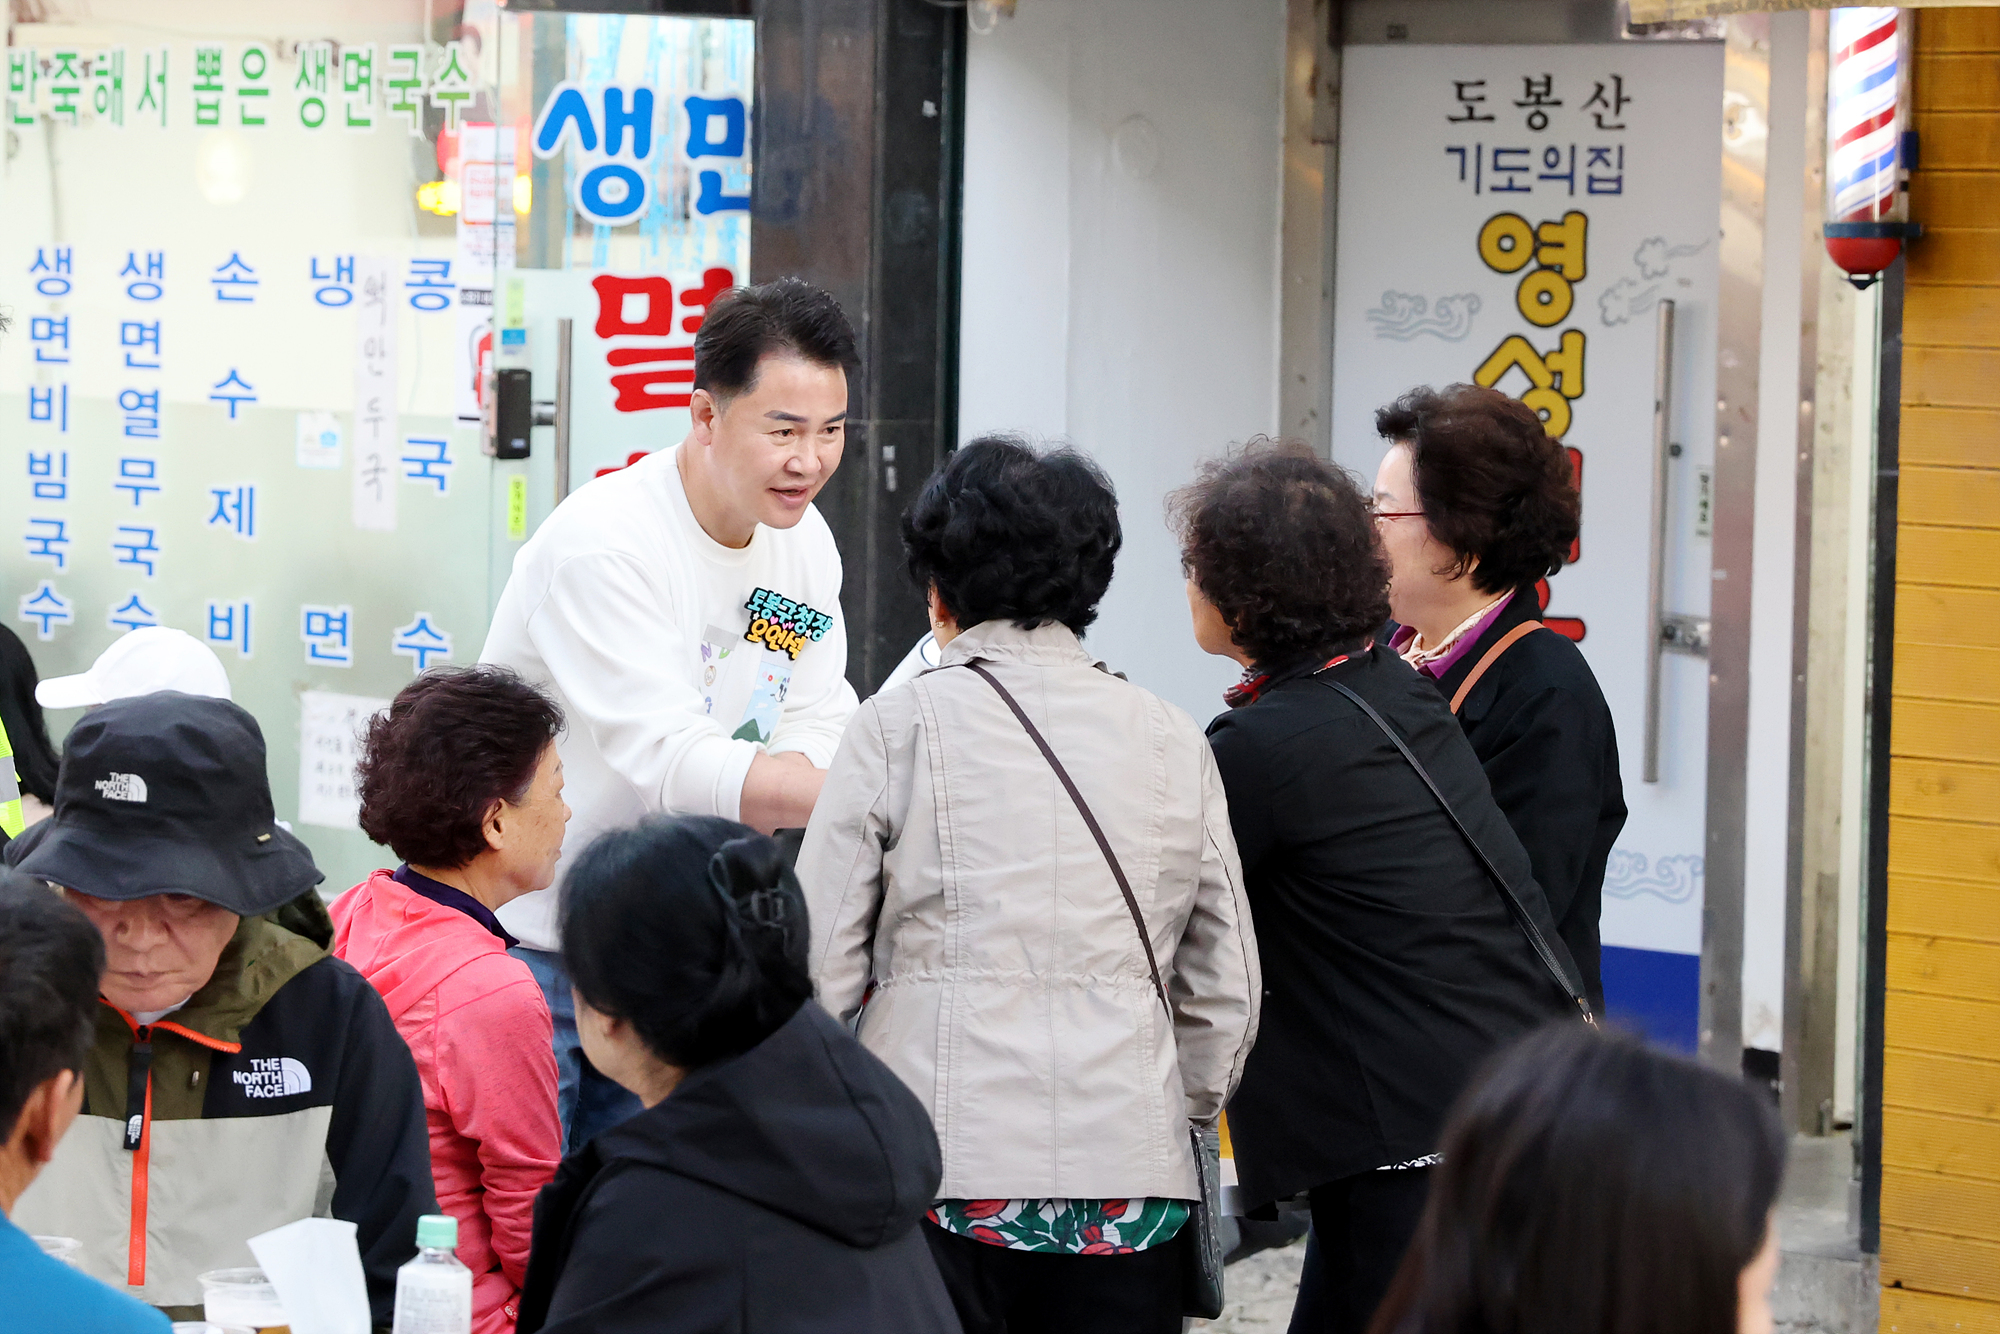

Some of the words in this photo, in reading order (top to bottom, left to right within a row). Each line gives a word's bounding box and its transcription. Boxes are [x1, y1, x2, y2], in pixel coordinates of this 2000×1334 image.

[9, 49, 168, 127] 반죽해서
[192, 47, 270, 126] 뽑은
[295, 47, 472, 130] 생면국수
[1446, 74, 1632, 132] 도봉산
[1446, 143, 1625, 195] 기도의집
[24, 247, 73, 635] 생면비빔국수
[209, 252, 260, 653] 손수제비
[397, 258, 456, 669] 콩국수
[747, 589, 834, 641] 도봉구청장
[746, 618, 808, 660] 오언석
[94, 779, 129, 792] NORTH
[102, 789, 128, 801] FACE
[109, 771, 130, 783] THE
[232, 1070, 283, 1085] NORTH
[250, 1057, 281, 1072] THE
[245, 1084, 284, 1099] FACE
